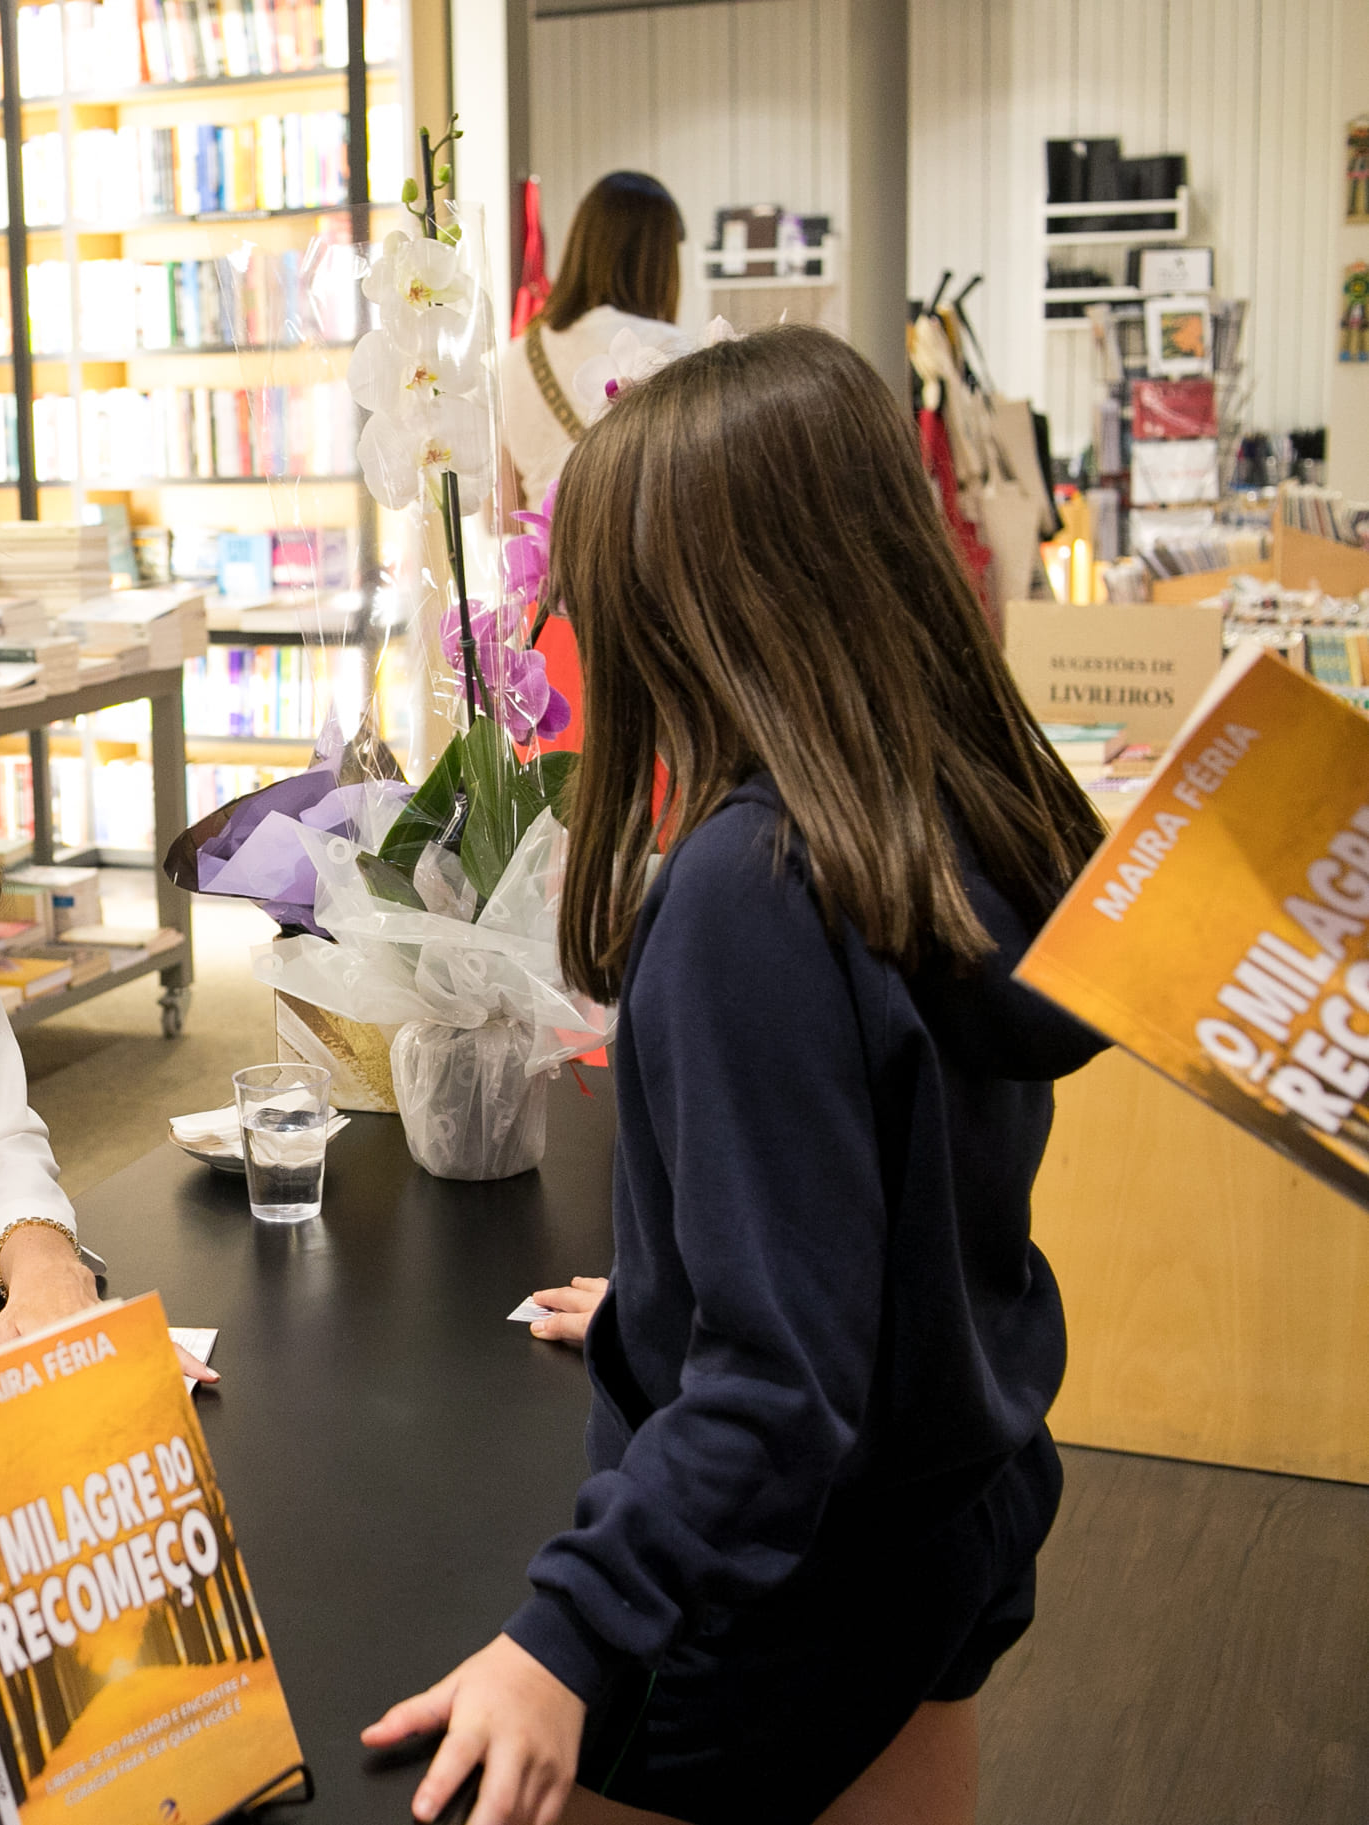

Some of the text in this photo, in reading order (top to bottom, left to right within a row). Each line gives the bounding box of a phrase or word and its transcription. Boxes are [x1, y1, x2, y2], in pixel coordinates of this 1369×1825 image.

[1049, 654, 1176, 676] SUGESTÕES DE
[1048, 684, 1176, 708] LIVREIROS
[1092, 722, 1261, 923] MAIRA FÉRIA
[1217, 804, 1369, 1043] MILAGR
[1194, 1016, 1260, 1070] O
[42, 1330, 118, 1381] FÉRIA
[154, 1435, 195, 1493] DO
